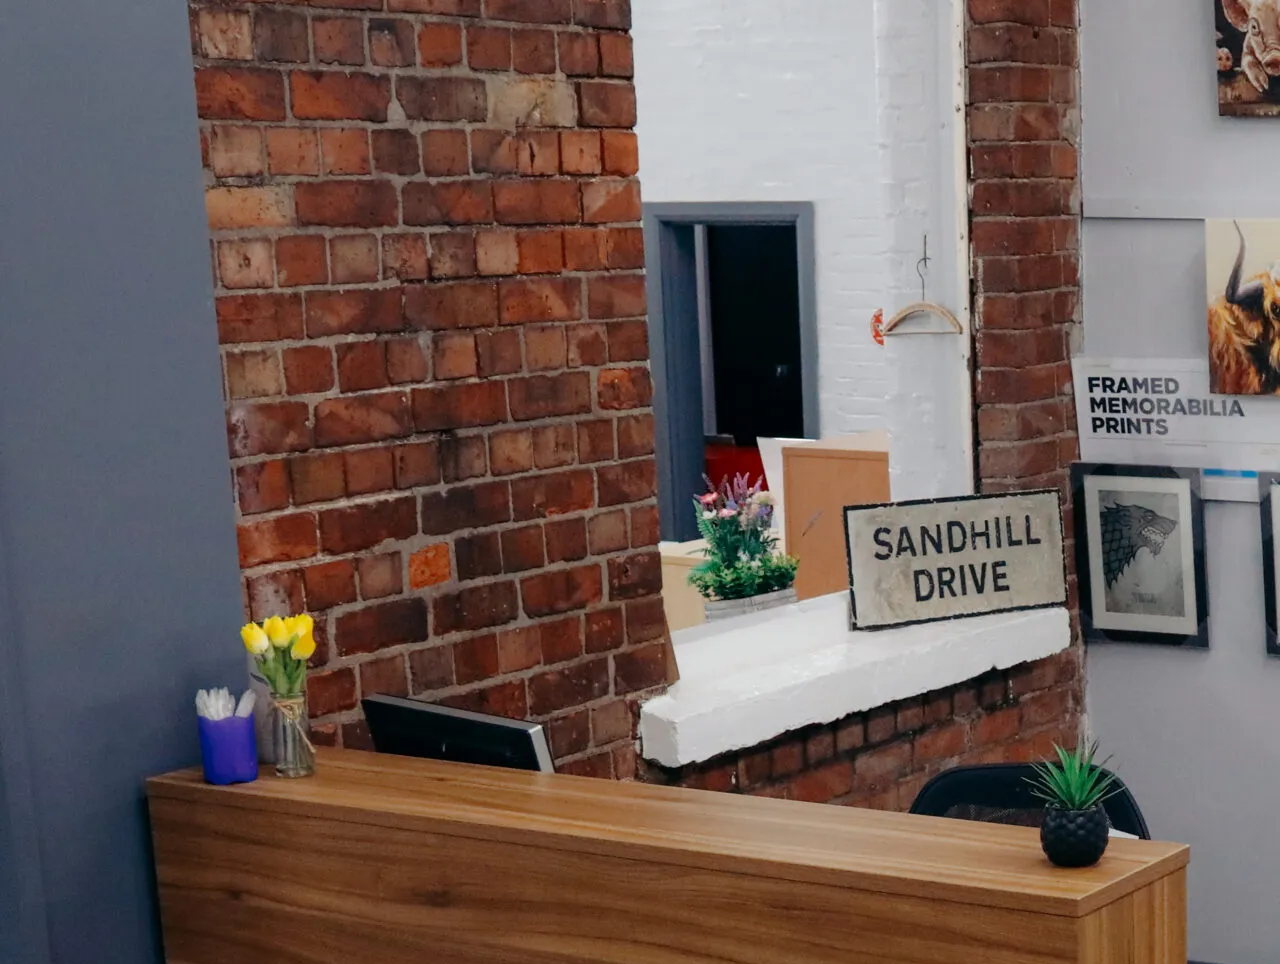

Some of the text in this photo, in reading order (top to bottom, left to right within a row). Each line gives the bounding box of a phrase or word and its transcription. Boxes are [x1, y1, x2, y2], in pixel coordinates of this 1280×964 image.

[1087, 376, 1180, 395] FRAMED
[1090, 396, 1245, 417] MEMORABILIA
[1091, 416, 1169, 435] PRINTS
[873, 514, 1042, 561] SANDHILL
[913, 560, 1010, 602] DRIVE
